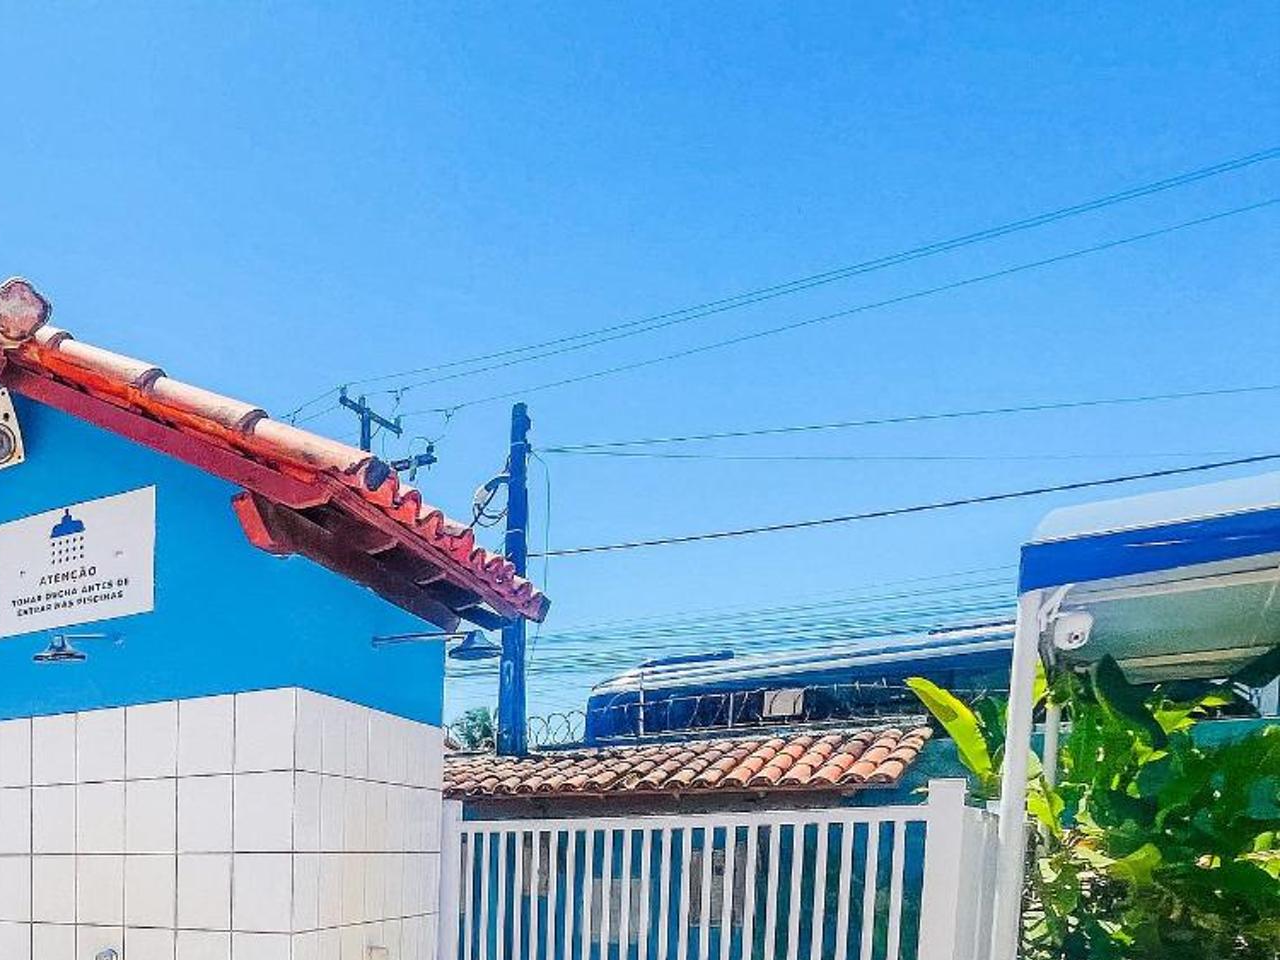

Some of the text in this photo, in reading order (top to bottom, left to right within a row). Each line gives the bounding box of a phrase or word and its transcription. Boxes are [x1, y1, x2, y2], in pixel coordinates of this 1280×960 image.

[39, 566, 97, 586] ATENÇÃO
[11, 578, 129, 608] TOMAR DUCHA ANTES DE
[16, 590, 124, 617] ENTRAR NAS PISCINAS
